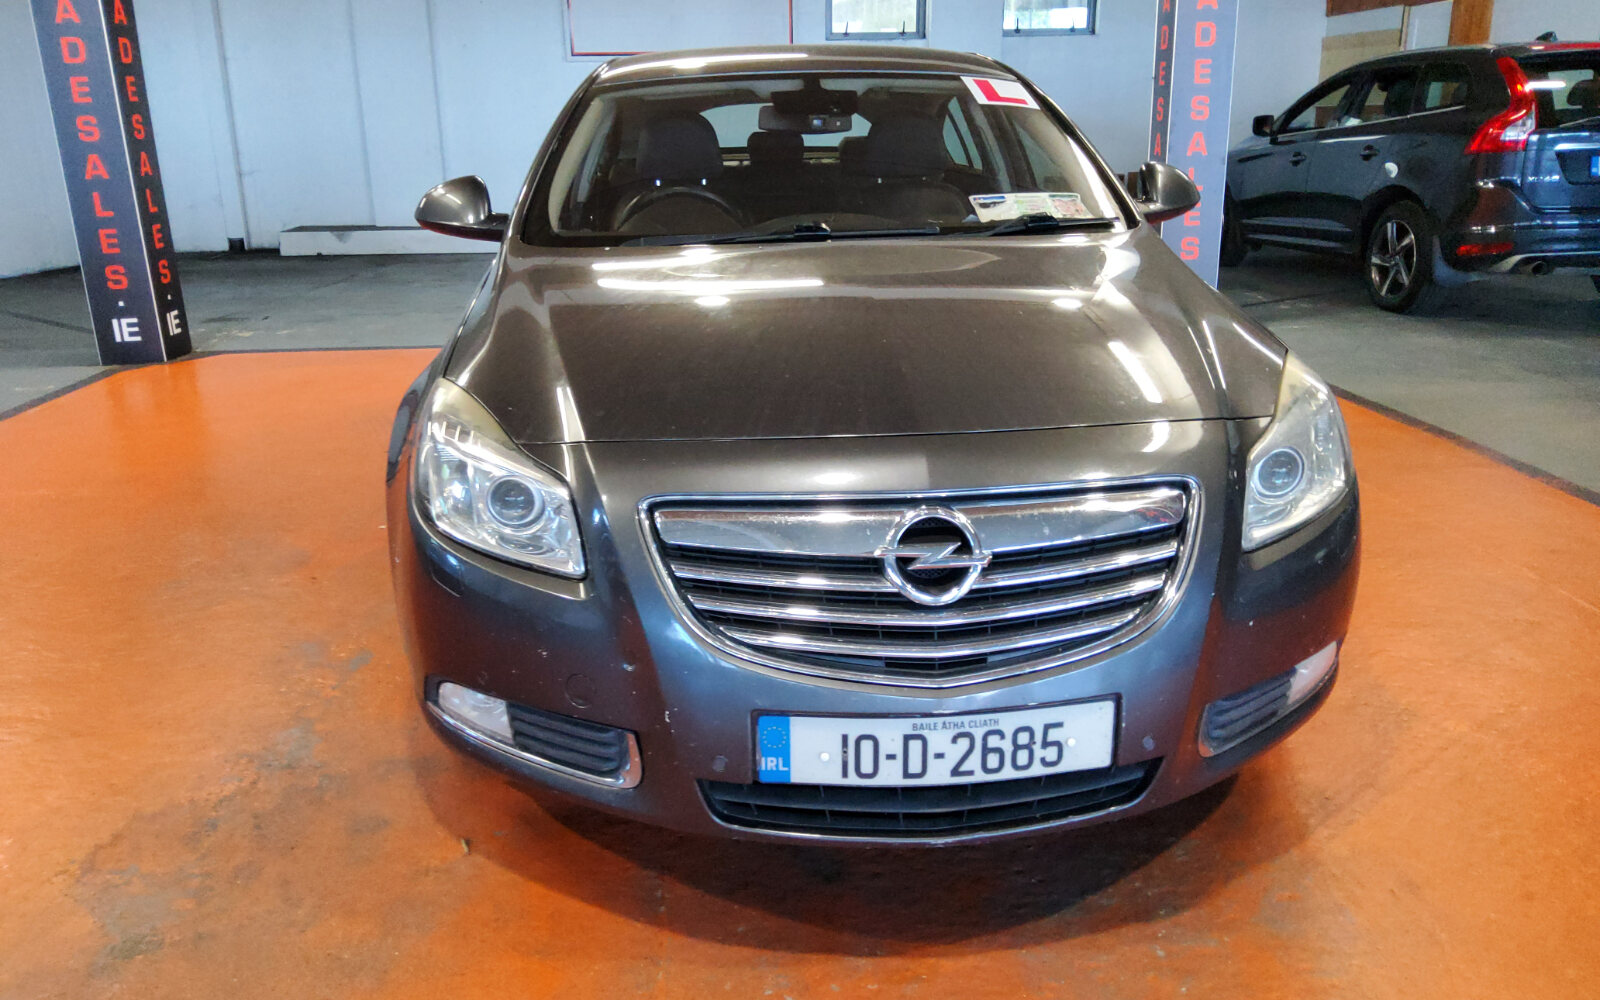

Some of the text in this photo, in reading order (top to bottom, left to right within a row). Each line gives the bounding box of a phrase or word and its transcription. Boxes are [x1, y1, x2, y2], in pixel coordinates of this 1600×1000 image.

[972, 78, 1029, 106] L
[912, 718, 1000, 732] BAILE ÁTHA CLIATH
[841, 721, 1064, 779] 10-D-2685
[760, 756, 789, 771] IRL
